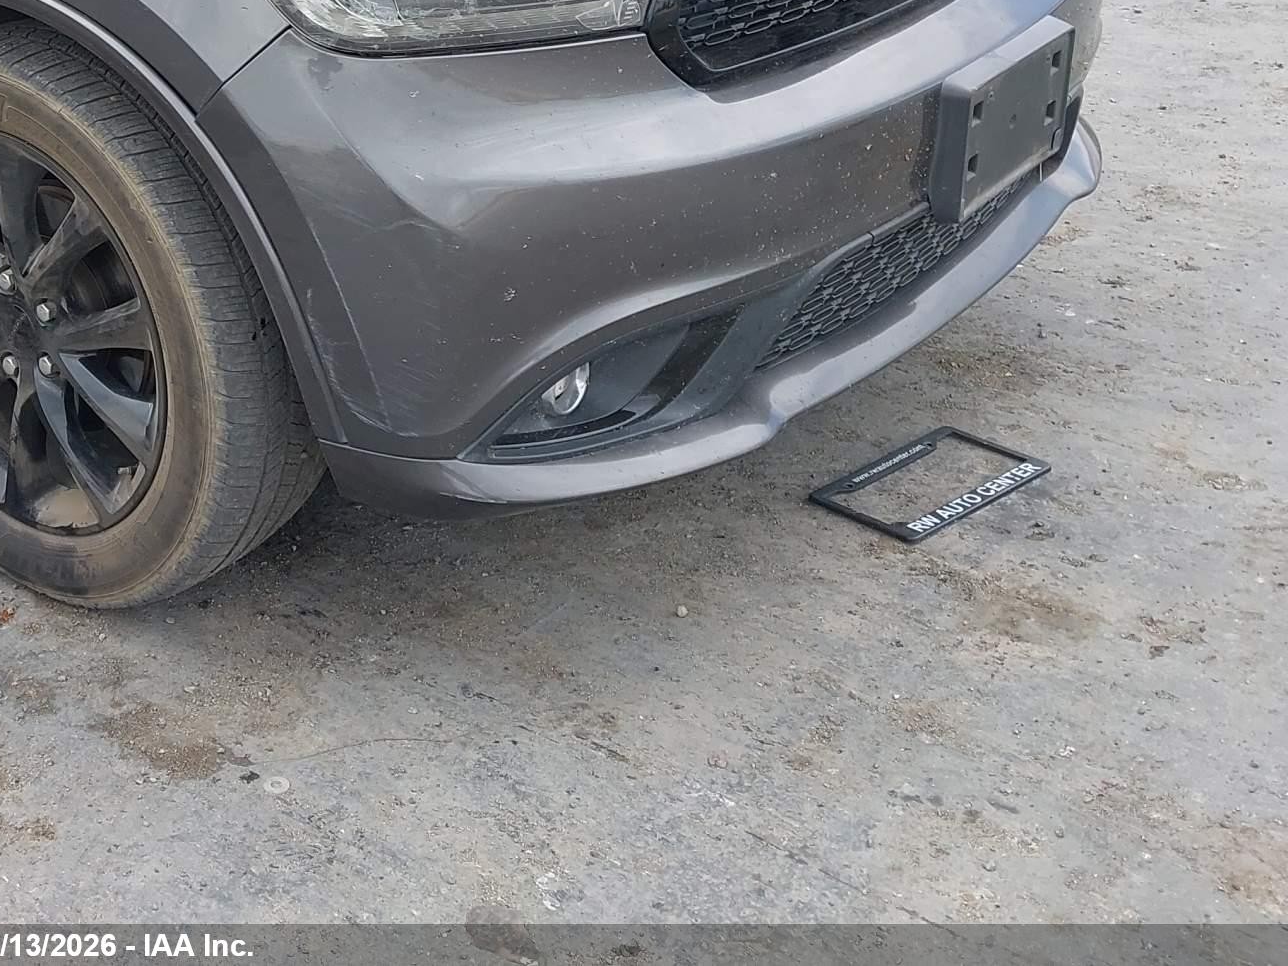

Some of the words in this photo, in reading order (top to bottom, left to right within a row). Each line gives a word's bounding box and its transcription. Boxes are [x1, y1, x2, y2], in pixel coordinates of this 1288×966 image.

[907, 514, 941, 532] RW
[935, 493, 982, 519] AUTO
[976, 462, 1042, 496] CENTER
